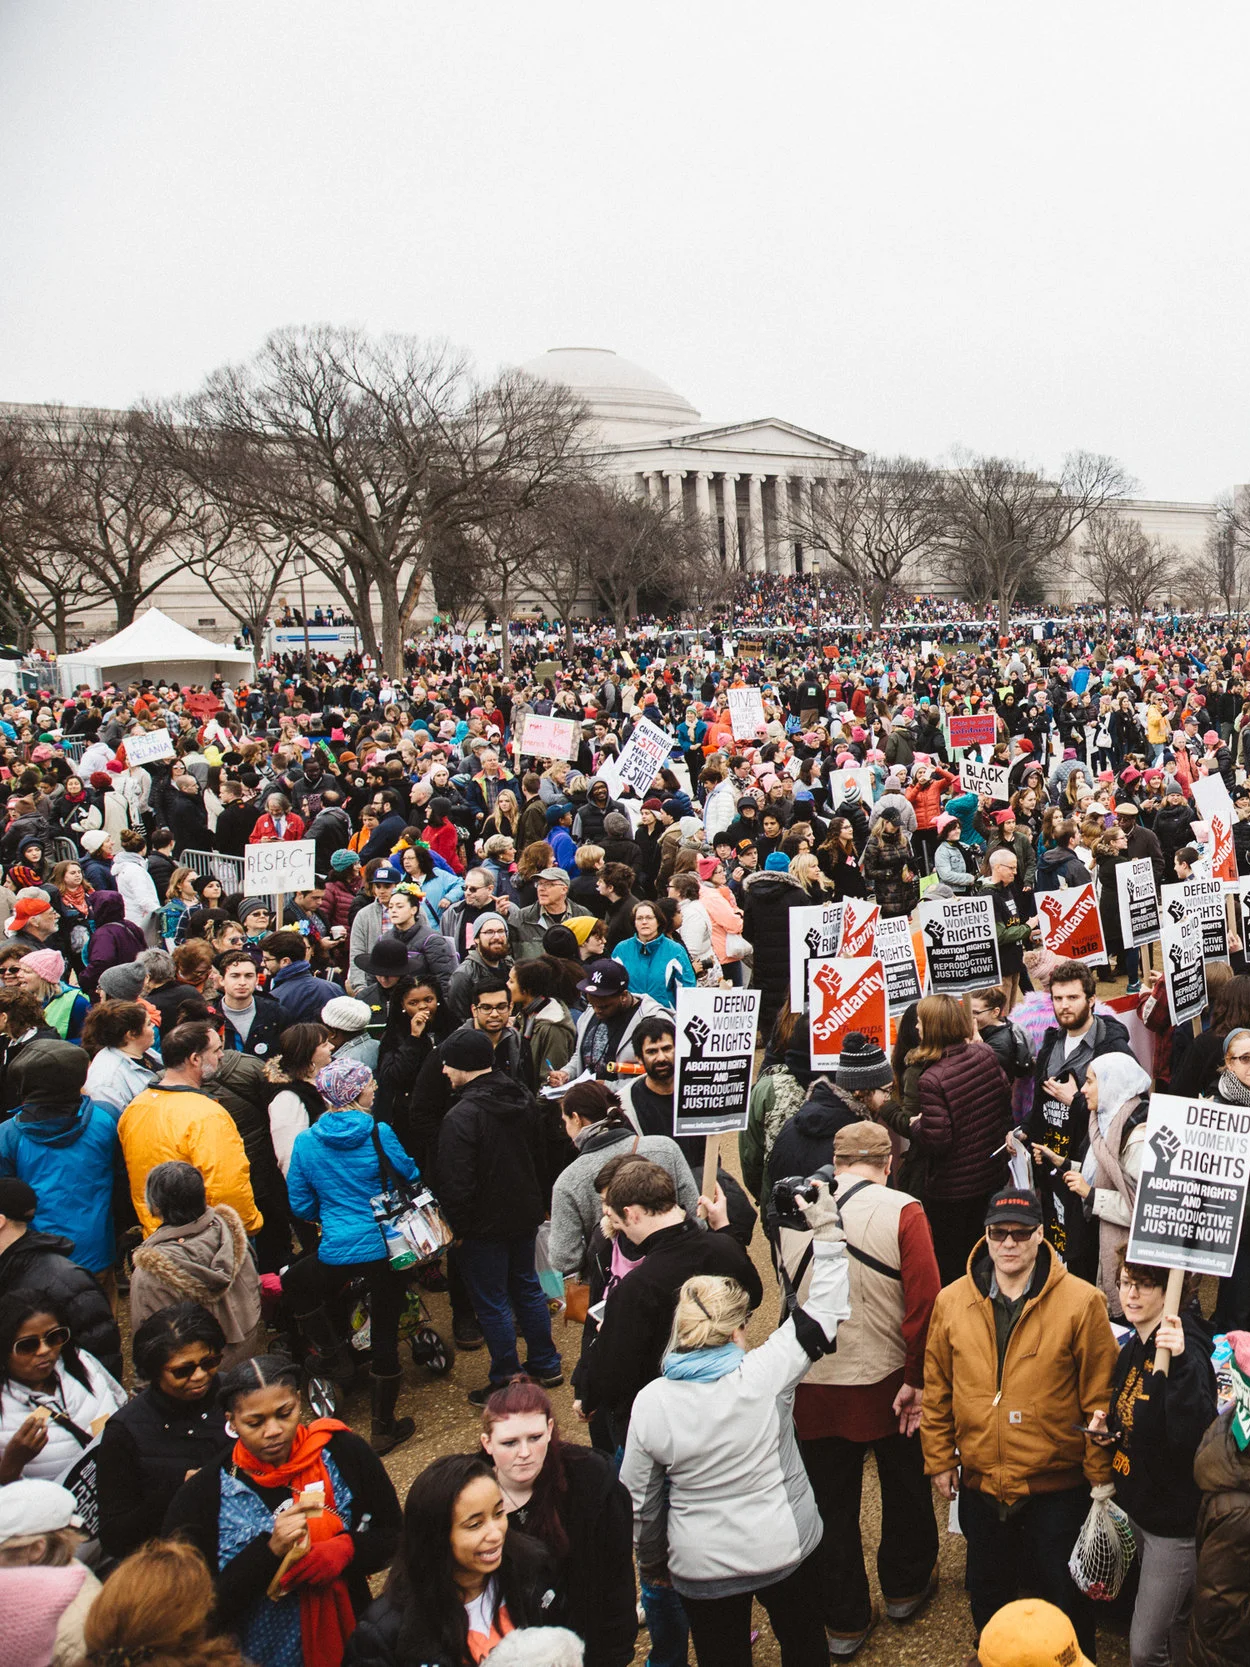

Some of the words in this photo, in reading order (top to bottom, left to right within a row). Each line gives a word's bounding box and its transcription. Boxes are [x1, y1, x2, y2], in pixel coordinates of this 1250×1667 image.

[131, 734, 156, 744] FREE
[130, 743, 169, 760] MELANIA
[632, 745, 649, 759] HAVE
[651, 758, 658, 766] TO
[638, 738, 663, 761] STILL
[619, 759, 632, 777] THIS
[631, 754, 656, 775] PROTEST
[628, 767, 653, 792] SHIT
[966, 764, 1004, 783] BLACK
[963, 777, 992, 795] LIVES
[248, 848, 314, 872] RESPECT
[1132, 861, 1150, 875] DEFEND
[1135, 883, 1154, 897] RIGHTS
[1184, 881, 1220, 897] DEFEND
[1185, 894, 1222, 907] WOMEN'S
[942, 900, 988, 918] DEFEND
[876, 919, 906, 937] DEFEND
[945, 913, 989, 928] WOMEN'S
[1045, 894, 1097, 950] Solidarity
[1132, 921, 1147, 931] JUSTICE
[1201, 922, 1222, 930] RIGHTS
[946, 924, 992, 942] RIGHTS
[880, 945, 912, 961] RIGHTS
[931, 947, 965, 956] ABORTION
[966, 942, 991, 953] RIGHTS
[1072, 940, 1098, 956] hate
[1204, 944, 1224, 952] NOW!
[933, 957, 993, 970] REPRODUCTIVE
[955, 953, 970, 961] AND
[895, 963, 913, 972] RIGHTS
[935, 969, 969, 979] JUSTICE
[971, 964, 994, 975] NOW!
[900, 987, 917, 997] NOW!
[714, 996, 755, 1013] DEFEND
[812, 971, 884, 1041] Solidarity
[713, 1015, 753, 1030] WOMEN'S
[711, 1032, 751, 1052] RIGHTS
[685, 1061, 726, 1072] ABORTION
[728, 1059, 746, 1069] RIGHTS
[713, 1073, 728, 1082] AND
[684, 1082, 744, 1095] REPRODUCTIVE
[683, 1097, 724, 1109] JUSTICE
[725, 1094, 743, 1106] NOW!
[1184, 1129, 1248, 1154] WOMEN'S
[1180, 1149, 1245, 1179] RIGHTS
[1148, 1177, 1200, 1195] ABORTION
[1201, 1186, 1237, 1201] RIGHTS
[1181, 1195, 1201, 1209] AND
[1143, 1204, 1234, 1229] REPRODUCTIVE
[1141, 1219, 1193, 1238] JUSTICE
[1196, 1226, 1231, 1244] NOW!
